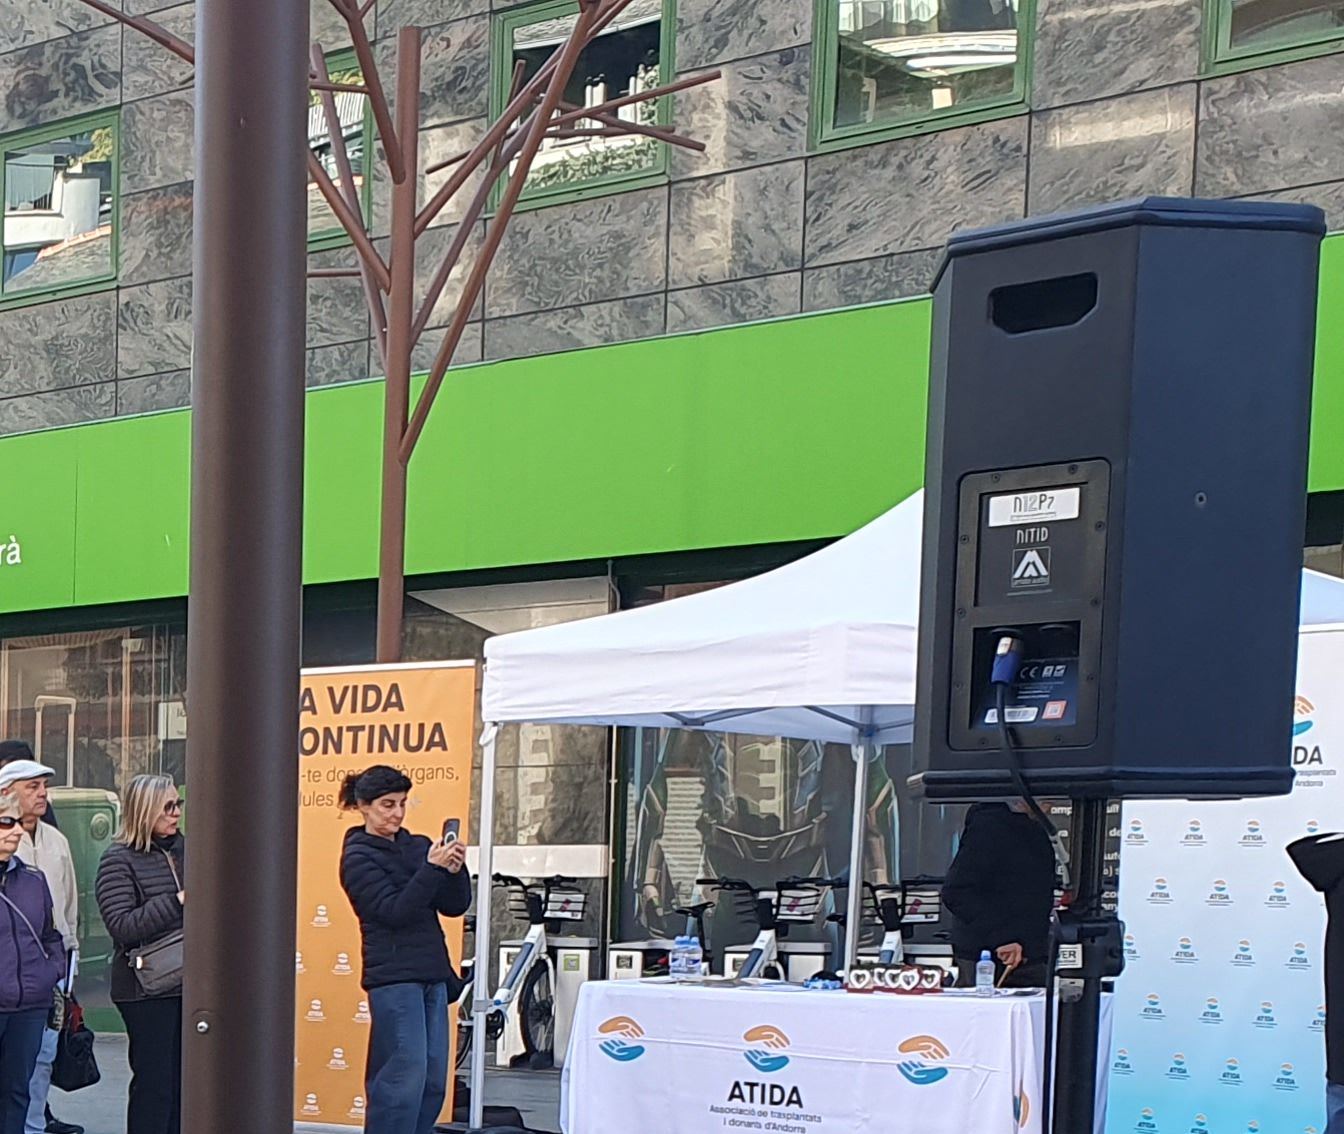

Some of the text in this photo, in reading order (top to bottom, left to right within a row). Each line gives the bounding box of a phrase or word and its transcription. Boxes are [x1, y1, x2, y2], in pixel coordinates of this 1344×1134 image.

[299, 683, 405, 716] A VIDA
[299, 722, 449, 757] ONTINUA
[300, 769, 322, 783] -te
[727, 1080, 804, 1109] ATIDA
